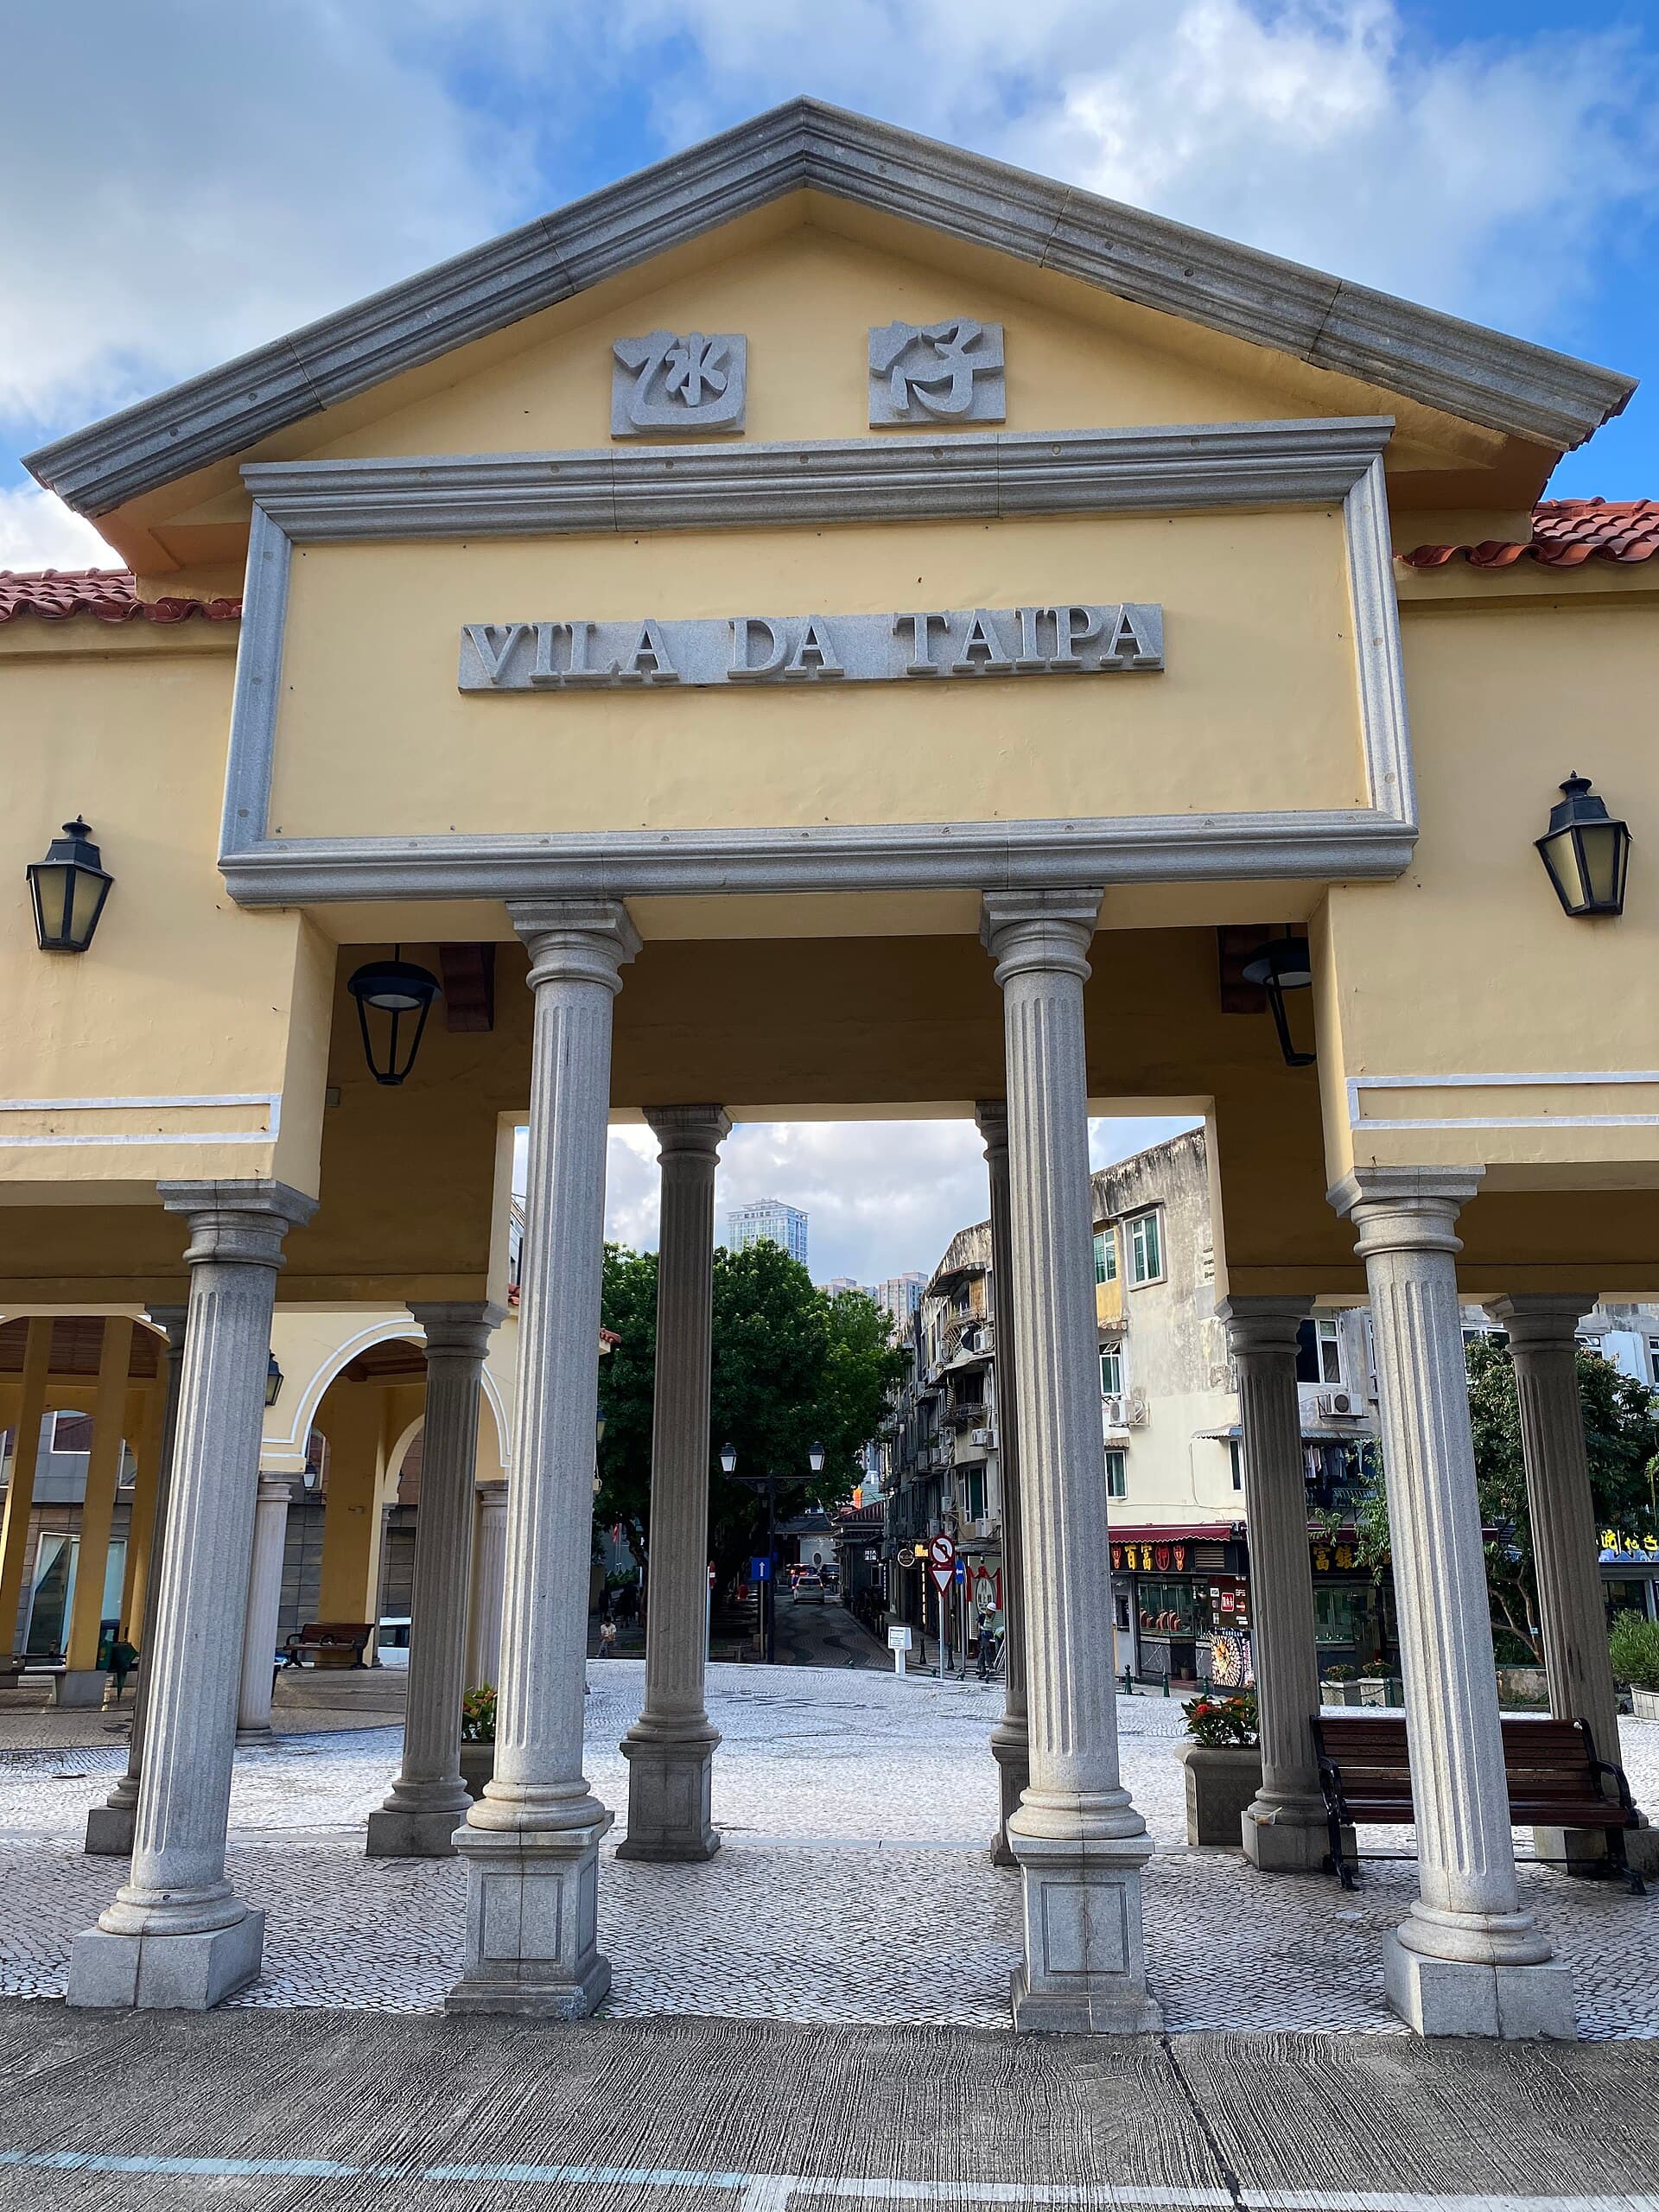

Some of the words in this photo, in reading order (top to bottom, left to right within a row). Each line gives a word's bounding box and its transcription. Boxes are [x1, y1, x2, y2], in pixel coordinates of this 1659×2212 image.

[612, 317, 1003, 425] 氹仔
[464, 620, 679, 683] VILA
[728, 614, 845, 679] DA
[892, 602, 1162, 675] TAIPA
